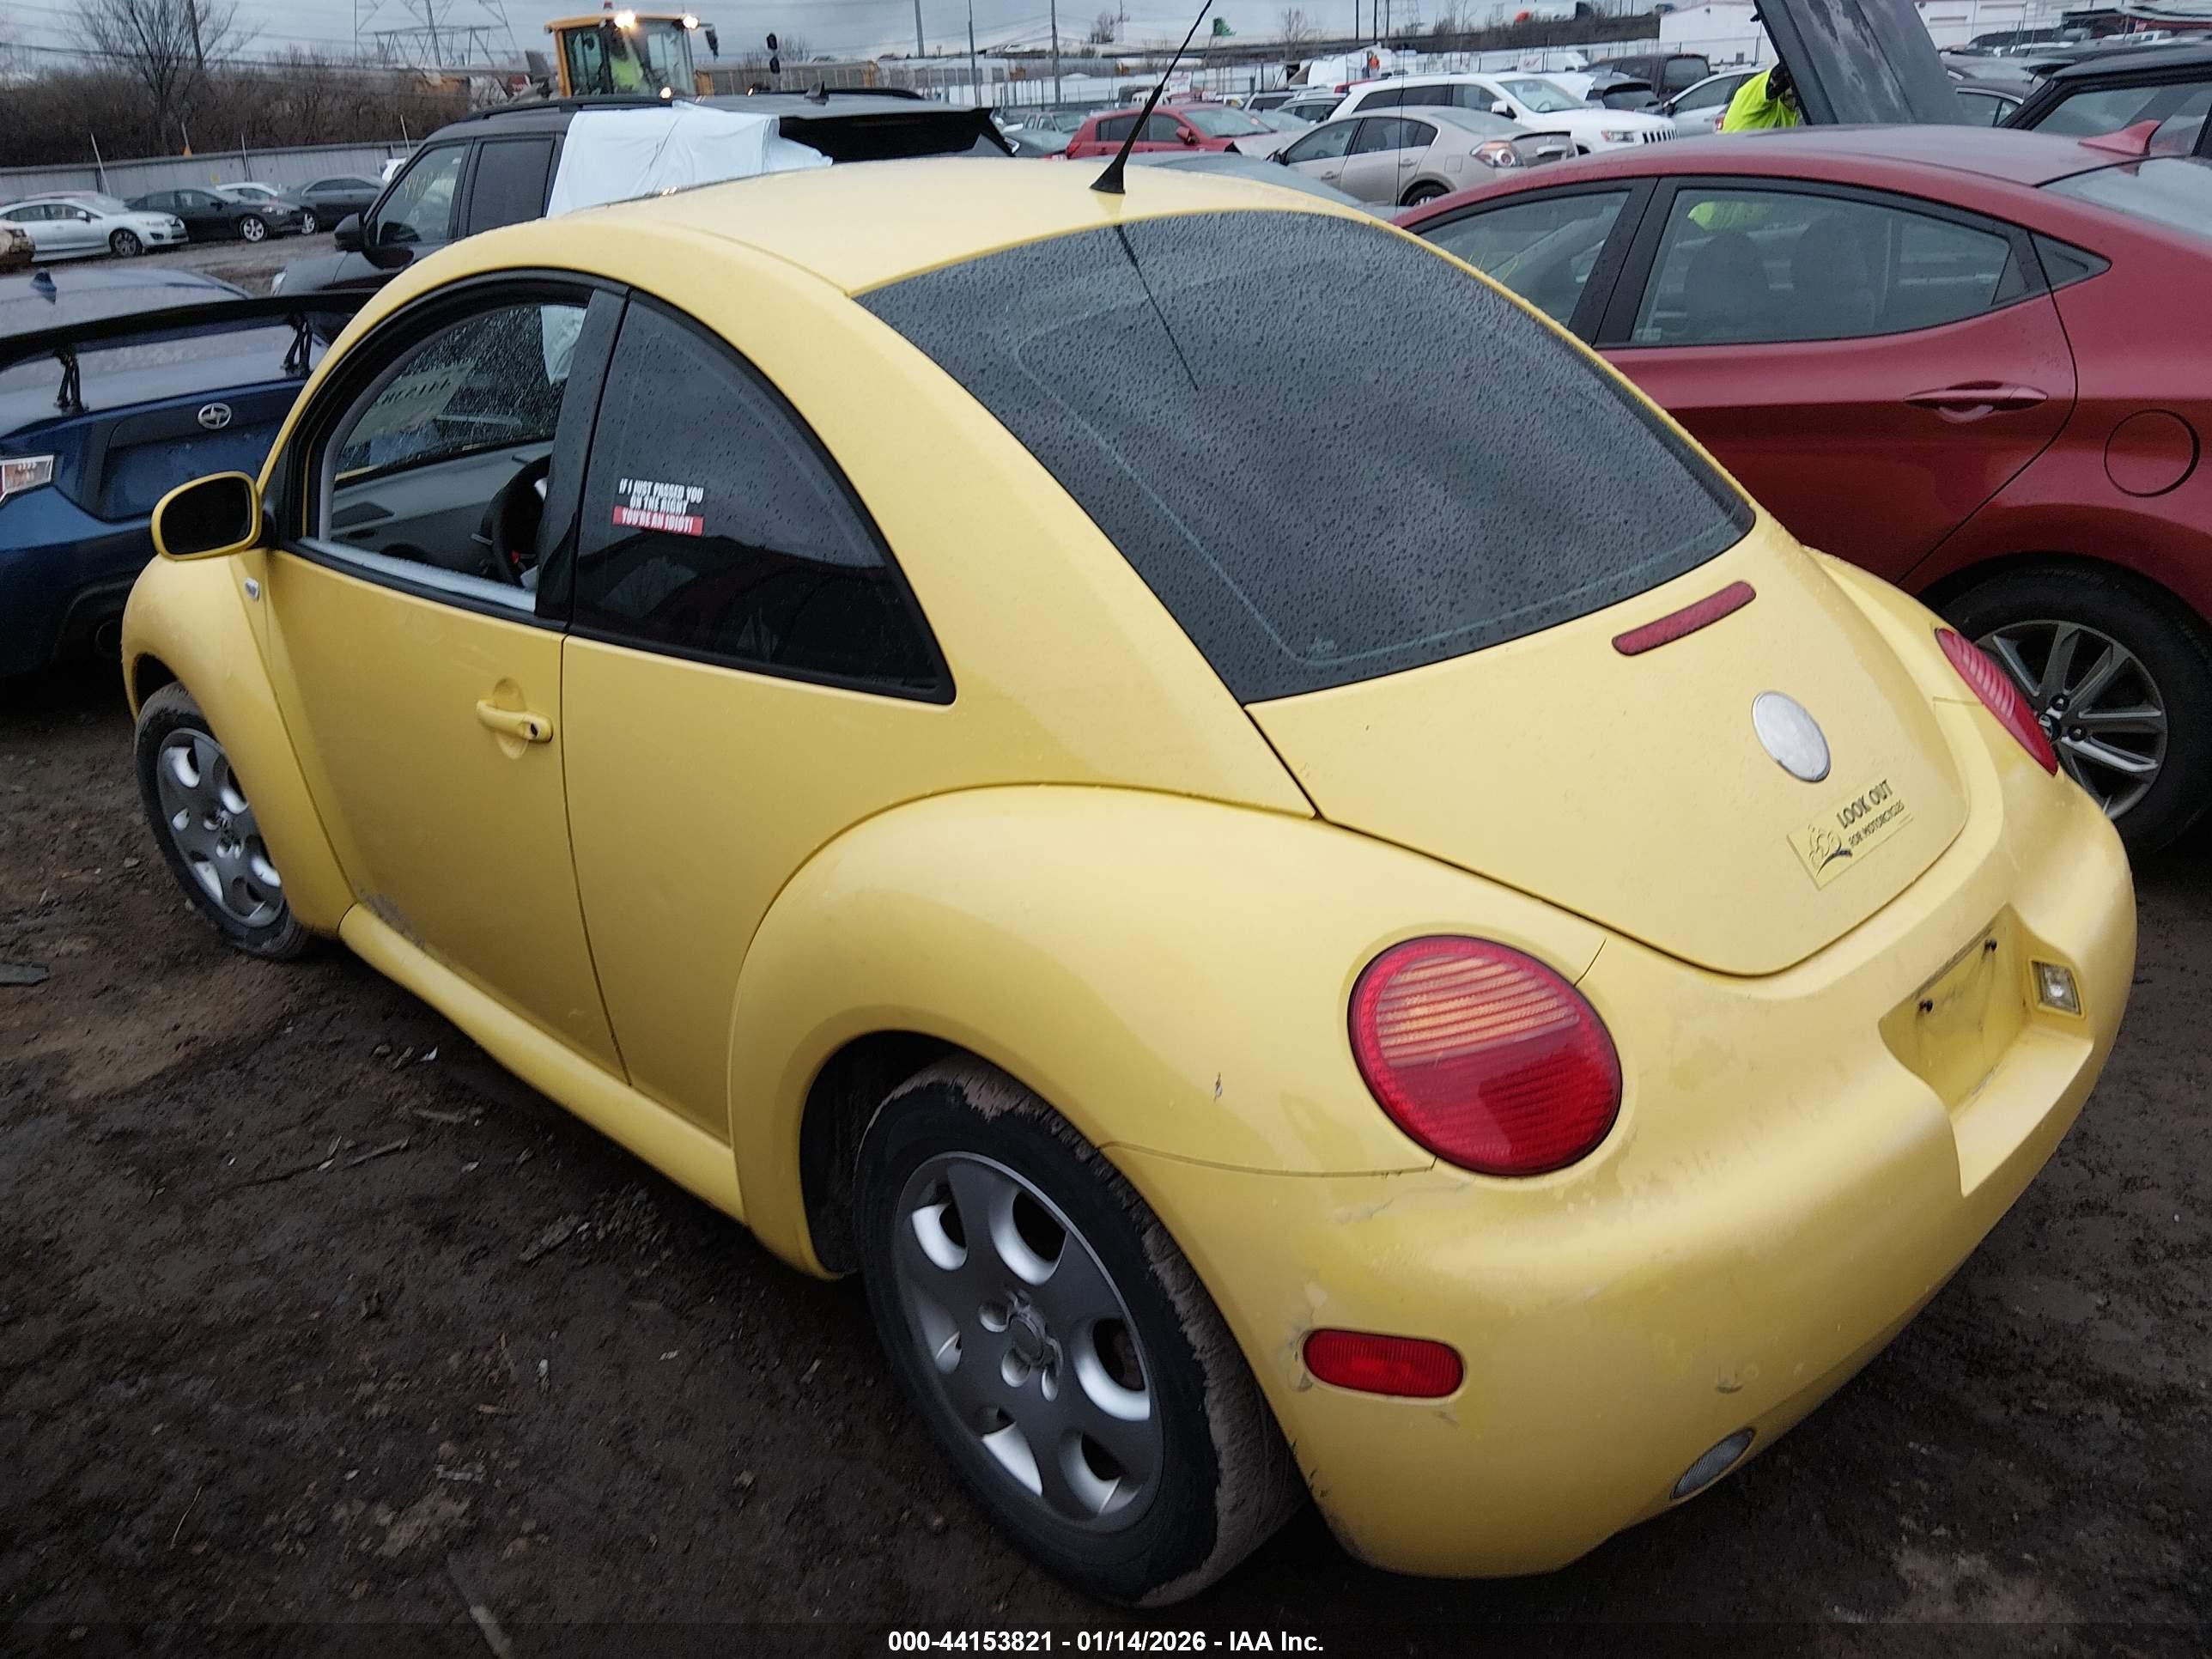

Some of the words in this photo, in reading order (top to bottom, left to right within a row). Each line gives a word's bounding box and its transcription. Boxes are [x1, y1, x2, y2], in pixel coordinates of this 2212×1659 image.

[618, 478, 628, 494] IF
[634, 480, 653, 496] JUST
[653, 483, 685, 499] PASSED
[686, 486, 704, 503] YOU
[630, 495, 642, 509] ON
[643, 496, 659, 512] THE
[660, 498, 689, 515] RIGHT
[622, 507, 651, 526] YOU'RE
[651, 513, 664, 528] AN
[665, 515, 694, 533] IDIOT!
[1837, 794, 1872, 829] LOOK
[1869, 778, 1893, 805] OUT
[1848, 831, 1863, 847] FOR
[1863, 799, 1905, 837] MOTORCYCLES
